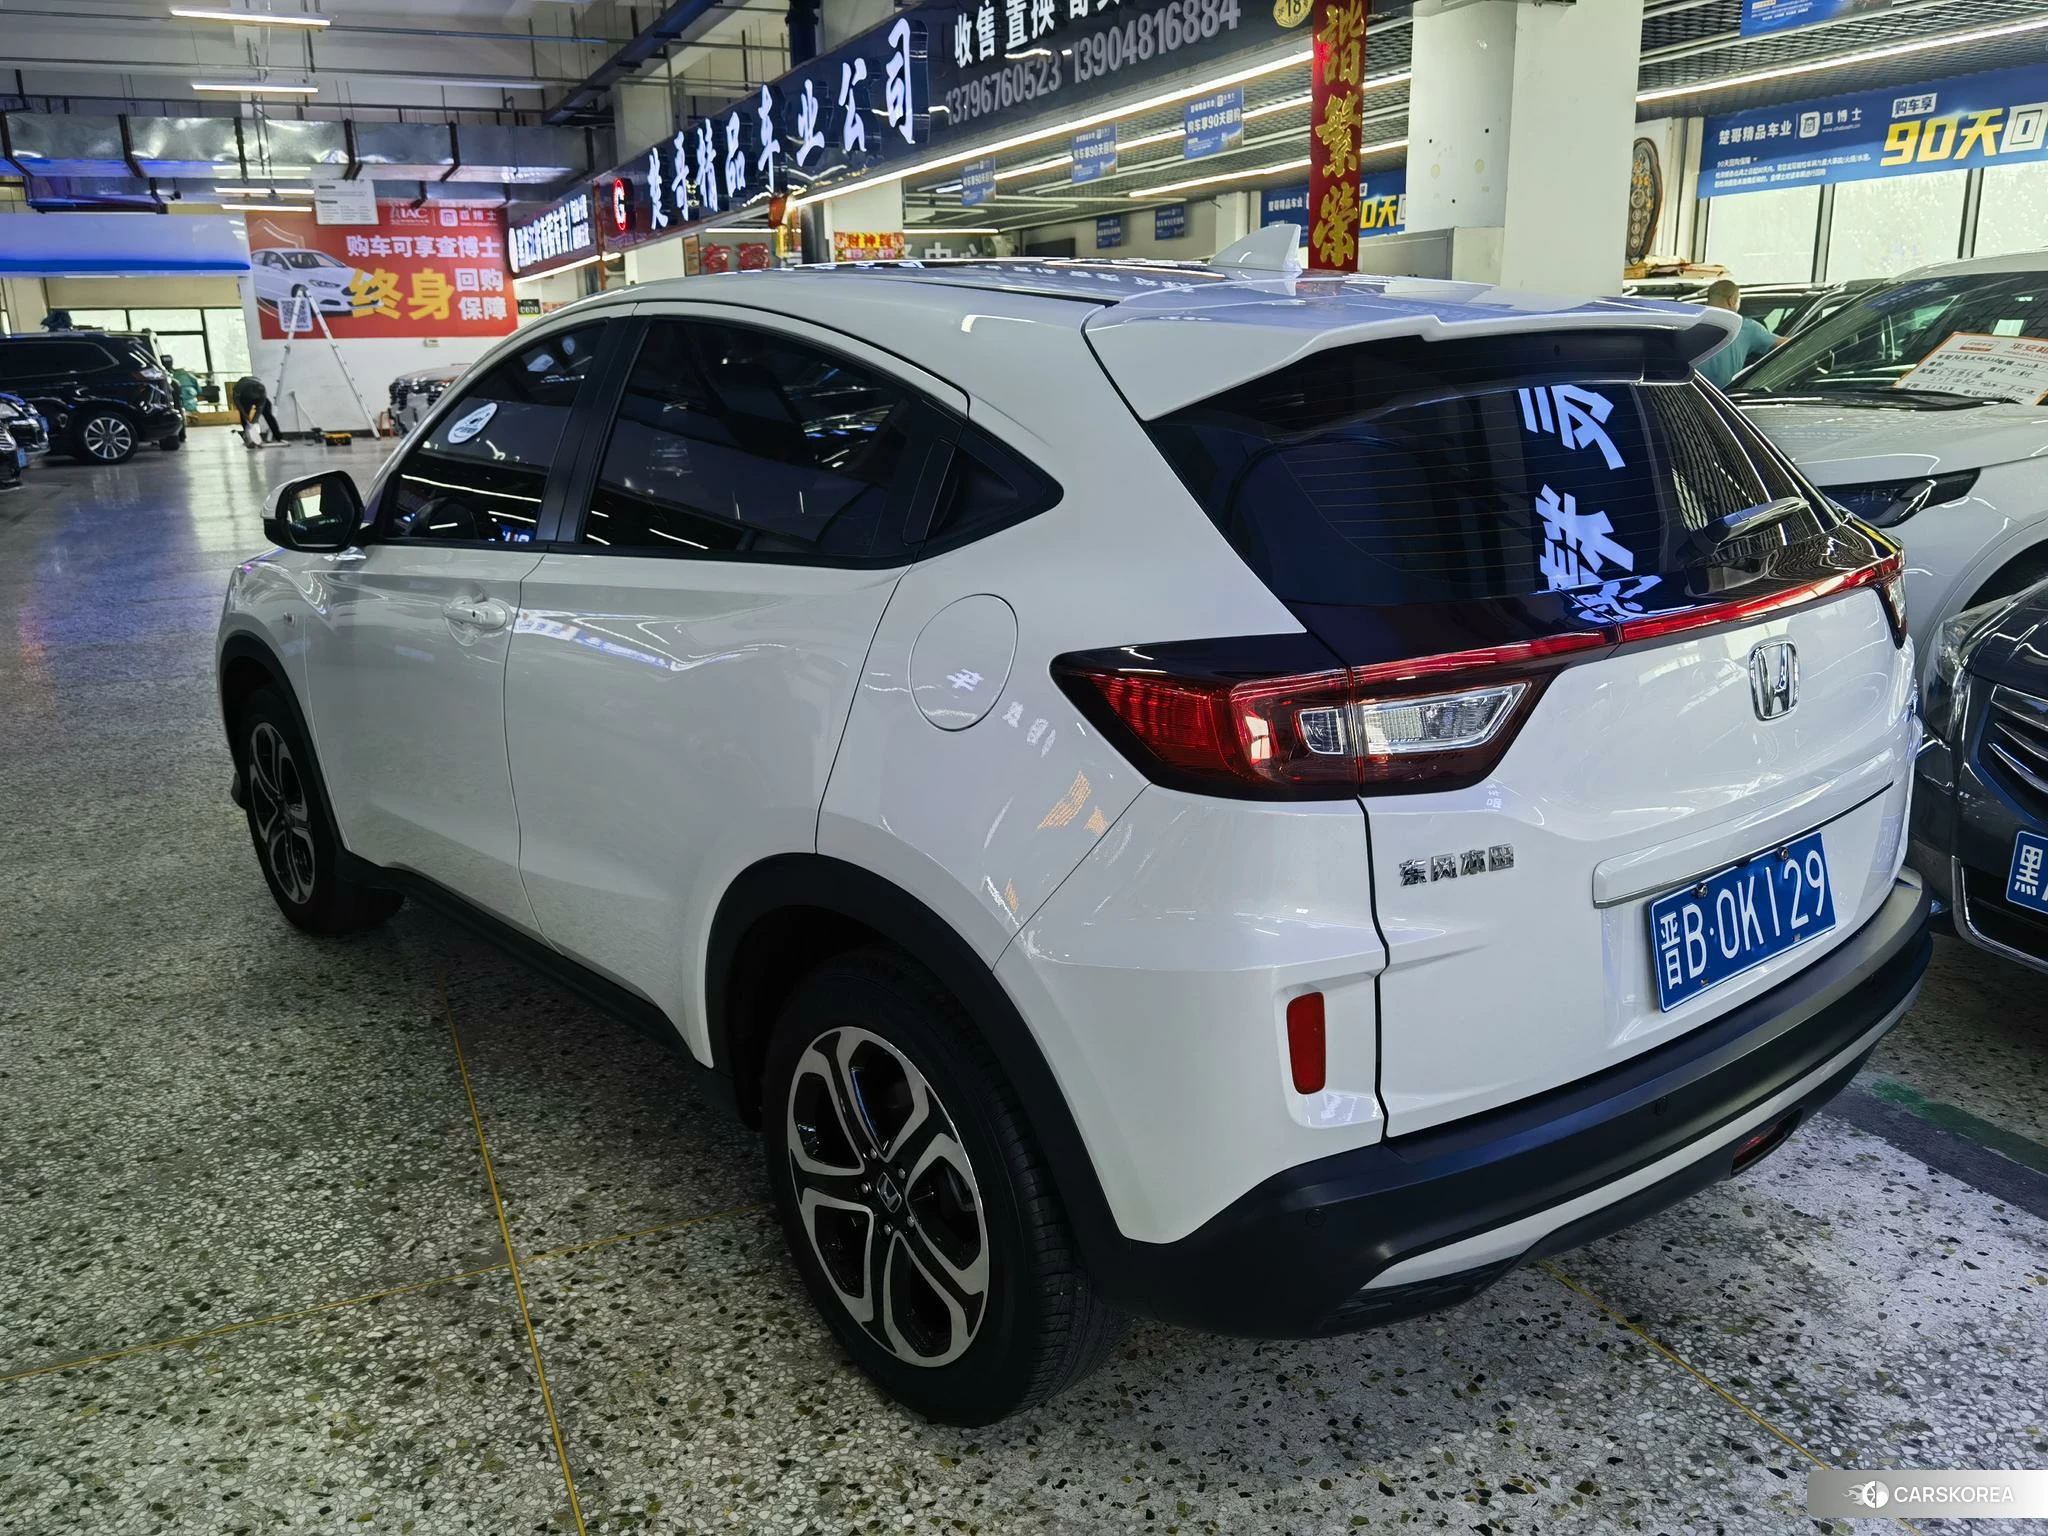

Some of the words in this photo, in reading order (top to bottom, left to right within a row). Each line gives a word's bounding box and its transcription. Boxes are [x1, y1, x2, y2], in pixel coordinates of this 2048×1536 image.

[954, 0, 996, 68] 收售
[945, 51, 1063, 126] 13796760523
[1073, 0, 1242, 84] 13904816884
[1895, 95, 1934, 116] 购车享
[1718, 120, 1792, 146] 楚哥精品车业
[346, 235, 501, 259] 购车可享查博士
[348, 267, 455, 321] 终身
[454, 267, 504, 293] 回购
[457, 296, 508, 321] 保障
[1399, 843, 1515, 887] 东风本田
[2014, 844, 2048, 901] 黑
